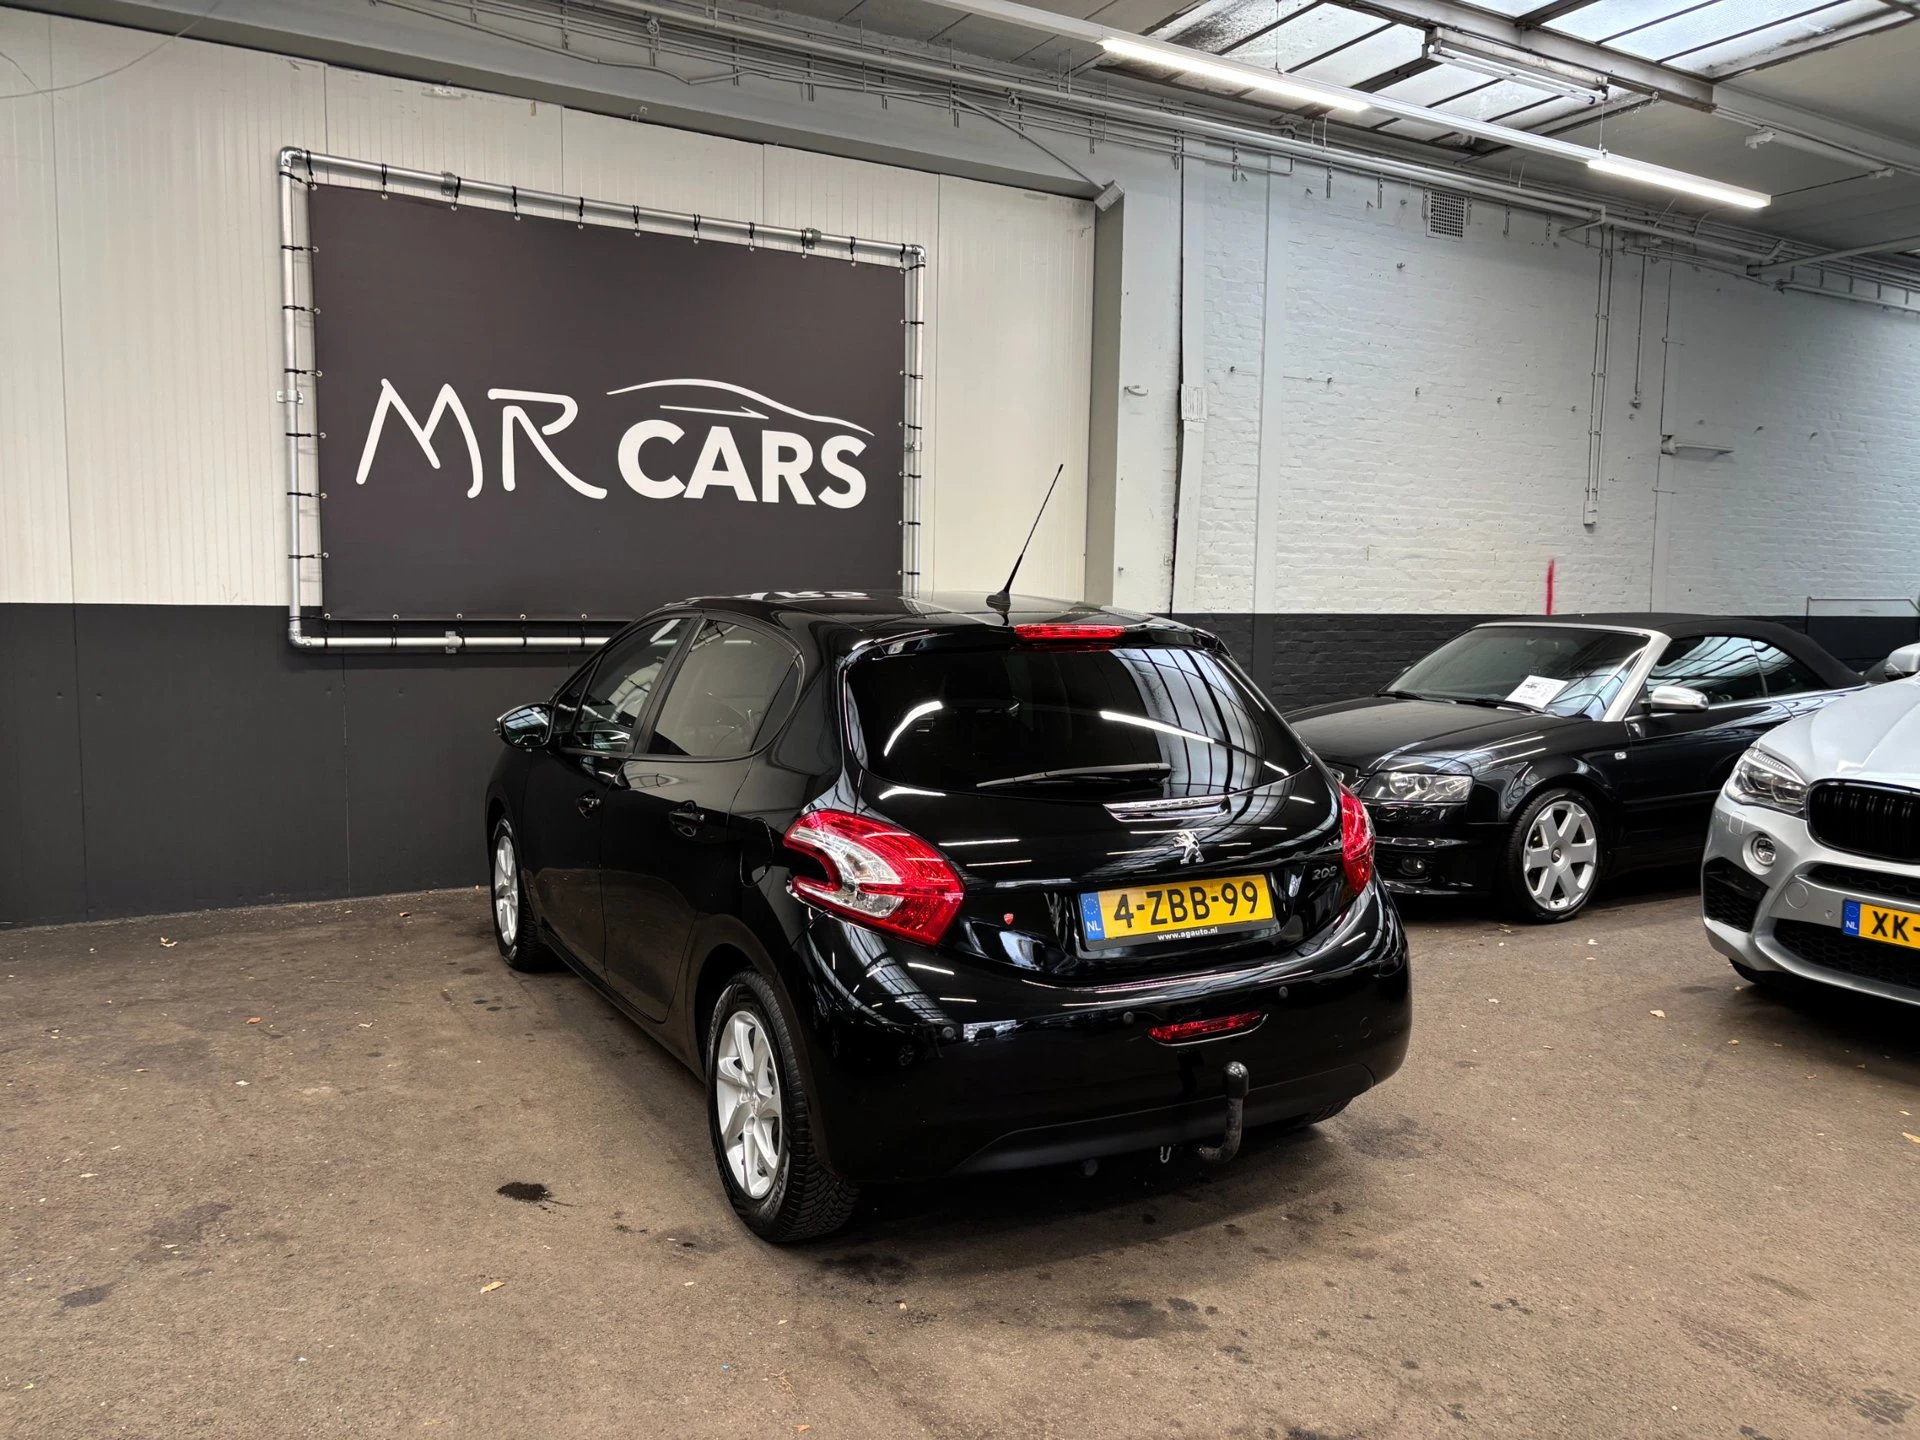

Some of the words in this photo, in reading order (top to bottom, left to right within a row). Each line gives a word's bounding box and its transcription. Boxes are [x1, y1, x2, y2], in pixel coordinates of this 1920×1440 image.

[355, 378, 608, 499] MR
[617, 419, 868, 509] CARS
[1114, 881, 1258, 928] 4-ZBB-99
[1087, 920, 1102, 932] NL
[1845, 920, 1858, 931] NL
[1157, 926, 1218, 941] www.agauto.nl
